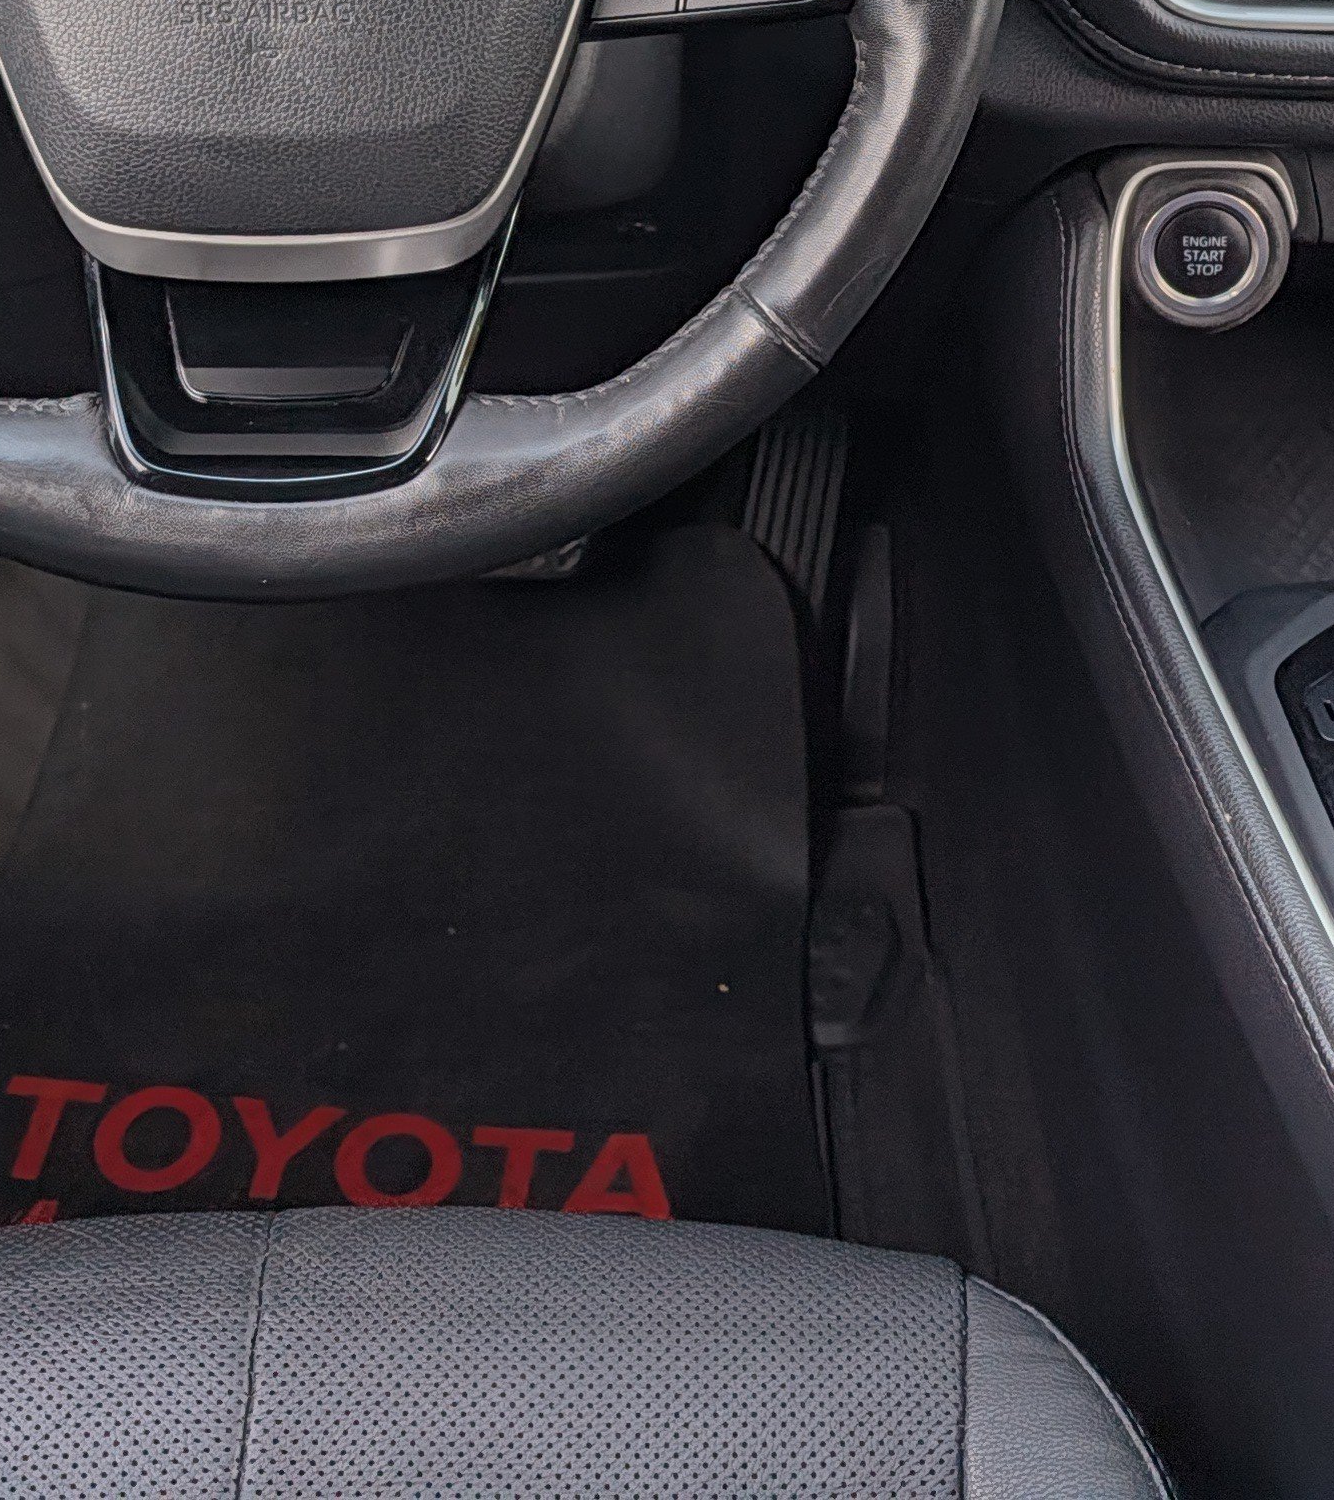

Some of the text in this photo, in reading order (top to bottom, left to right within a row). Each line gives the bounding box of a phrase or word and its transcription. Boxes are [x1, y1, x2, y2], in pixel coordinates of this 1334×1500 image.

[1182, 235, 1228, 247] ENGINE
[1182, 250, 1226, 262] START
[1186, 263, 1223, 276] STOP
[5, 1075, 672, 1219] TOYOTA
